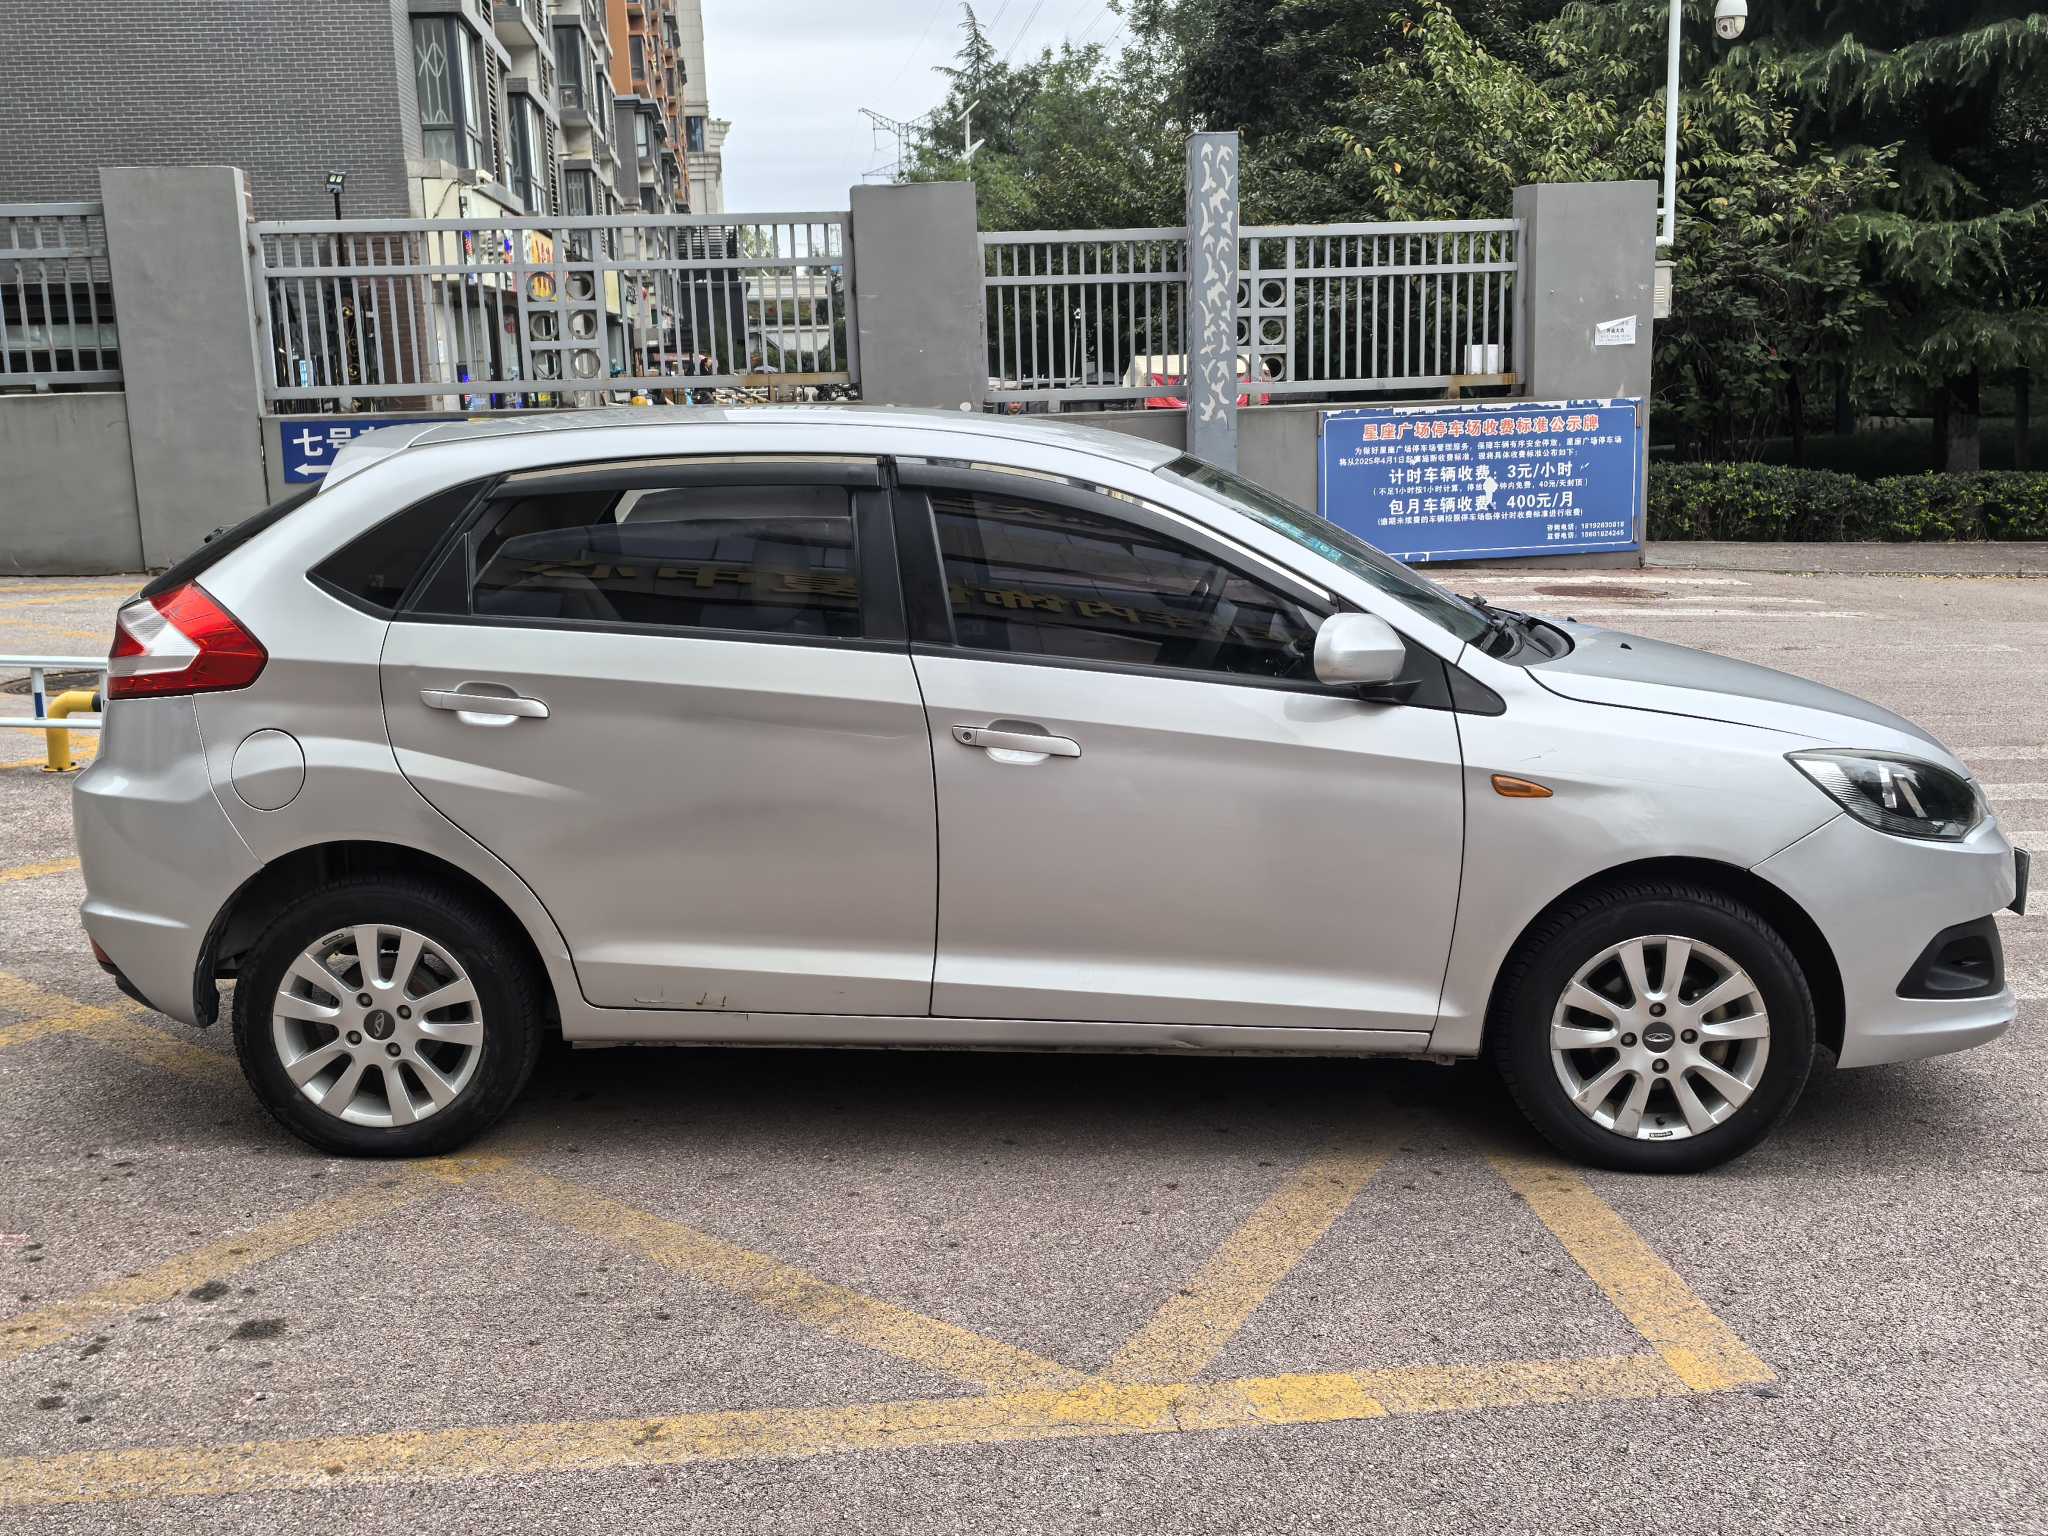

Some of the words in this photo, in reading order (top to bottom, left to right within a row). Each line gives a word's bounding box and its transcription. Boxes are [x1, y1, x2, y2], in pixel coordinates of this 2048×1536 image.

[292, 426, 375, 457] 七号
[1363, 414, 1599, 441] 星座广场停车场收费标准公示牌
